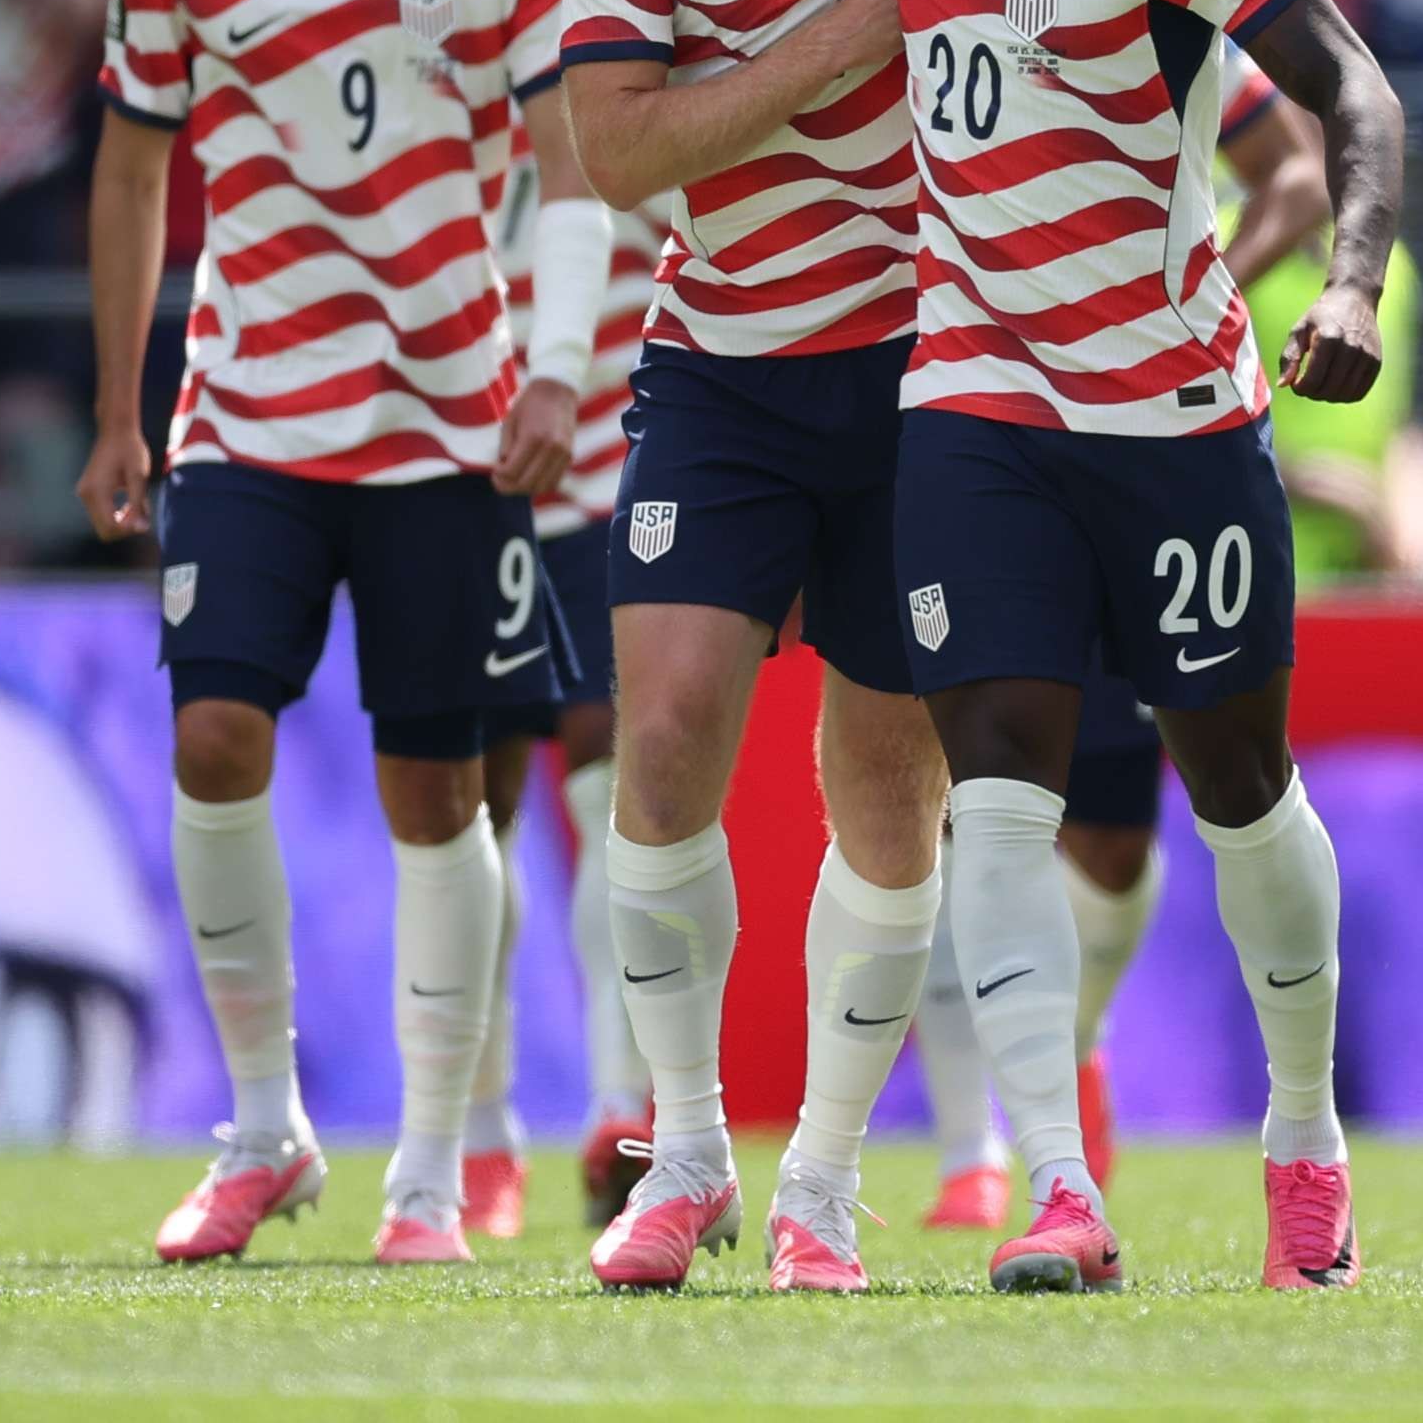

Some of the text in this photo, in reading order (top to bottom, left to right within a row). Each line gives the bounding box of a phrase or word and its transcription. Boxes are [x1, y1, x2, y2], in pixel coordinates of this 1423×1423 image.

[341, 61, 376, 152] 9
[927, 33, 1002, 141] 20
[635, 505, 674, 527] USA
[495, 536, 536, 640] 9
[911, 586, 941, 614] USA
[1153, 525, 1253, 635] 20
